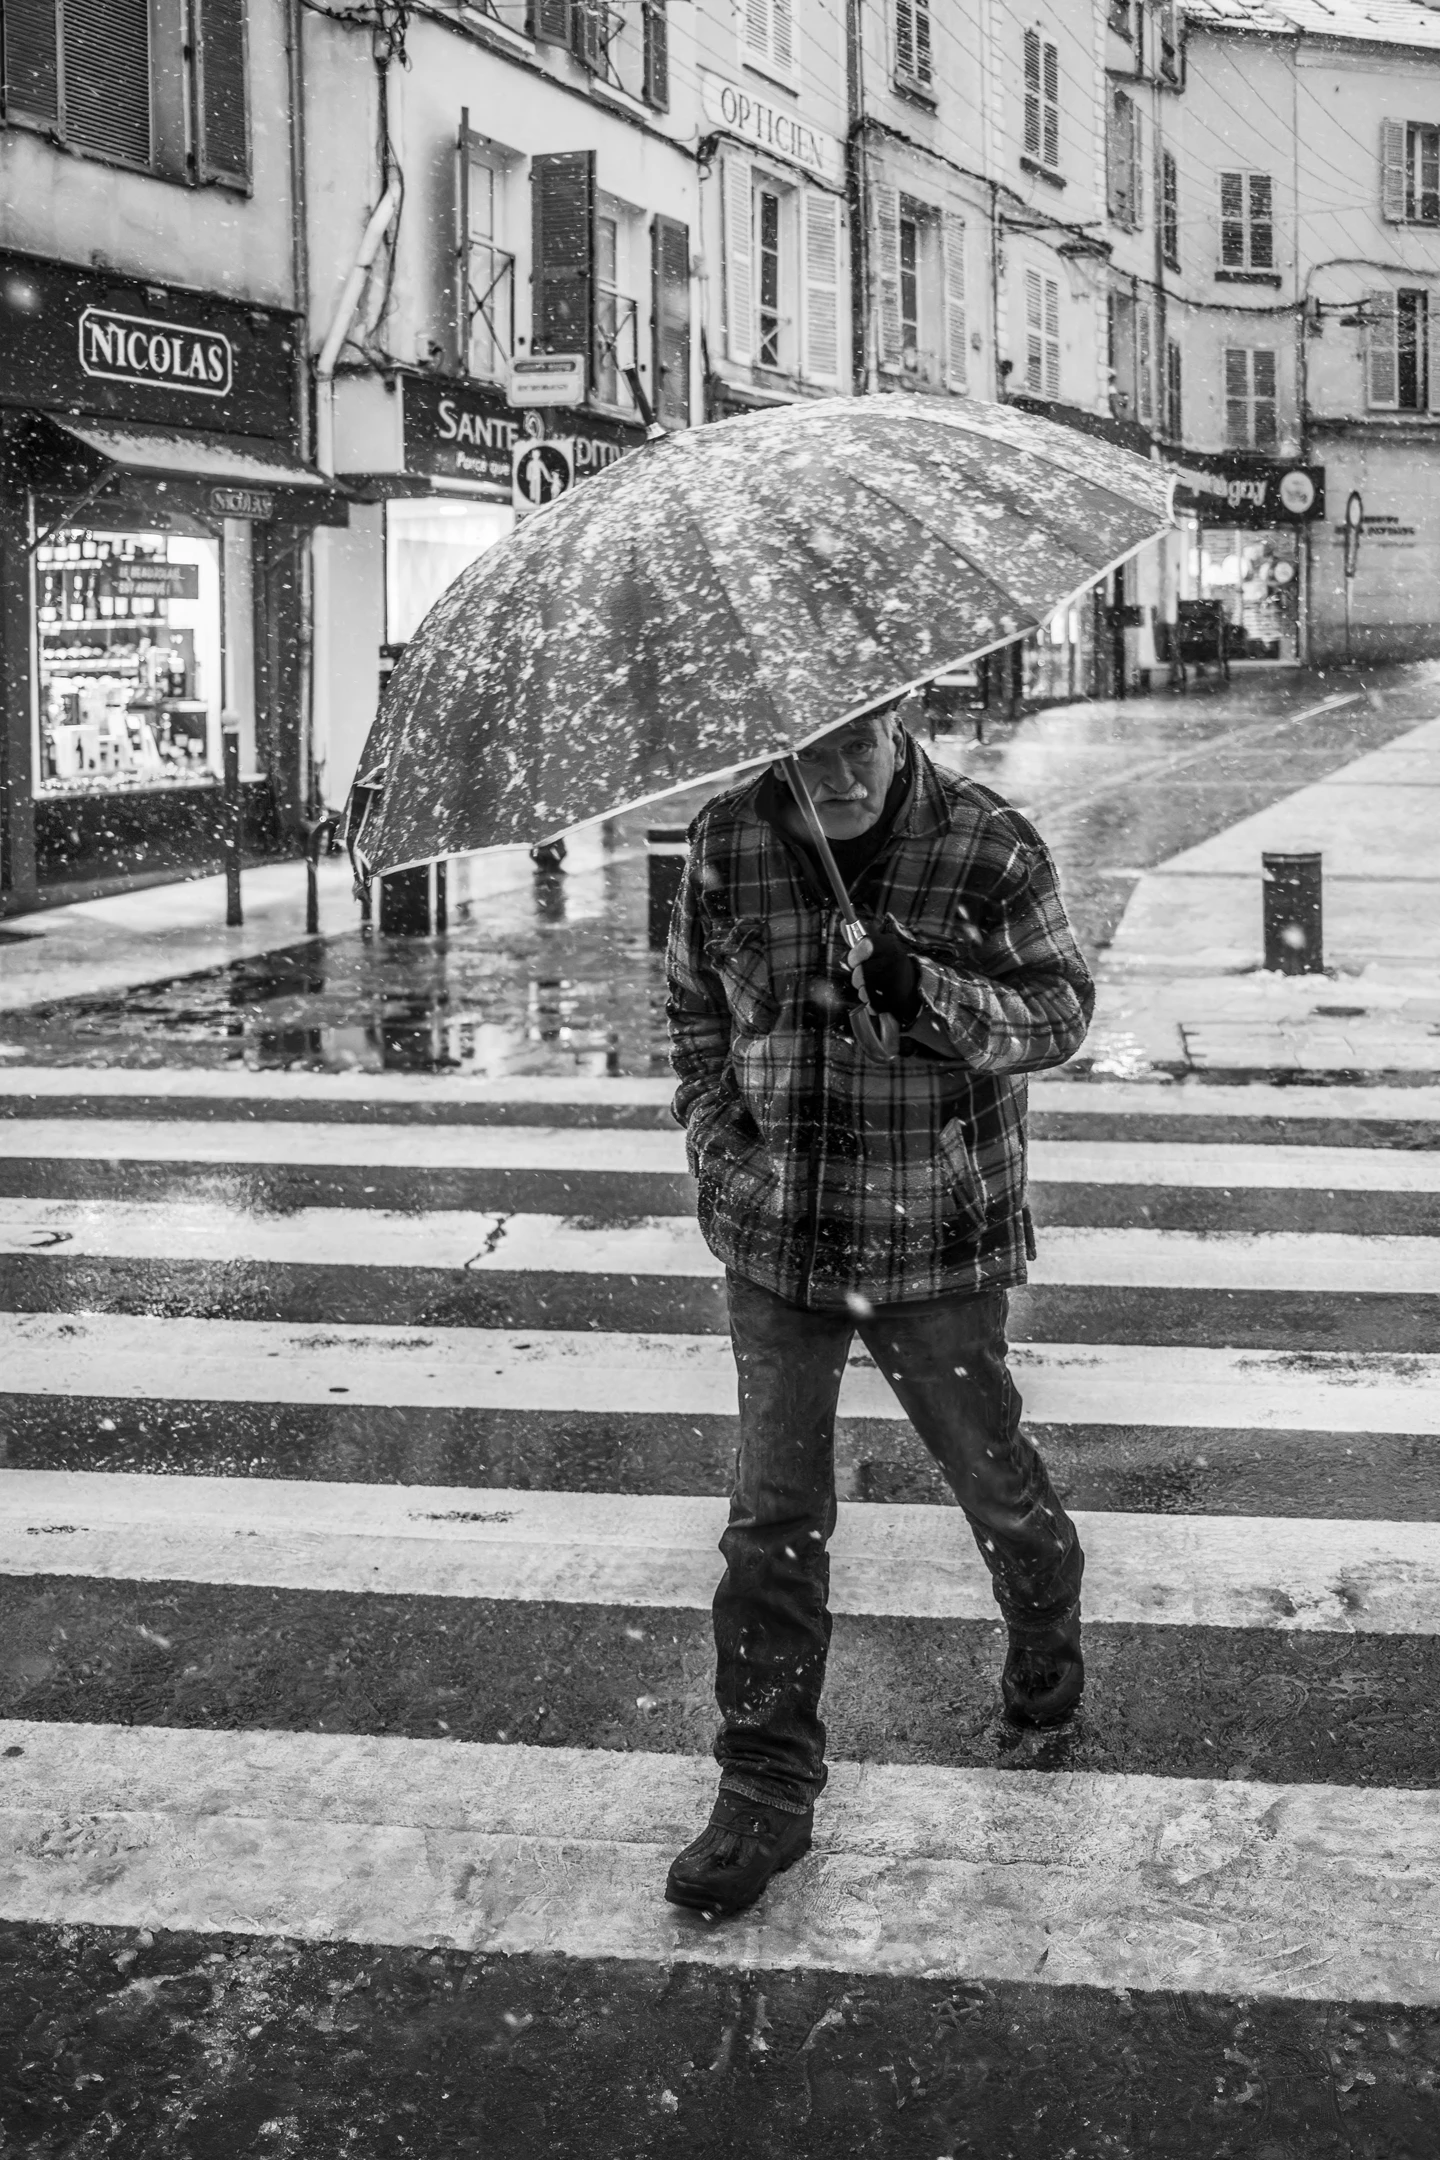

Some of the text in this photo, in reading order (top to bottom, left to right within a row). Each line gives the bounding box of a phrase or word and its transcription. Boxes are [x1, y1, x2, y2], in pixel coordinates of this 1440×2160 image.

[721, 87, 824, 169] OPTICIEN
[84, 320, 224, 382] NICOLAS
[438, 400, 519, 450] SANTE
